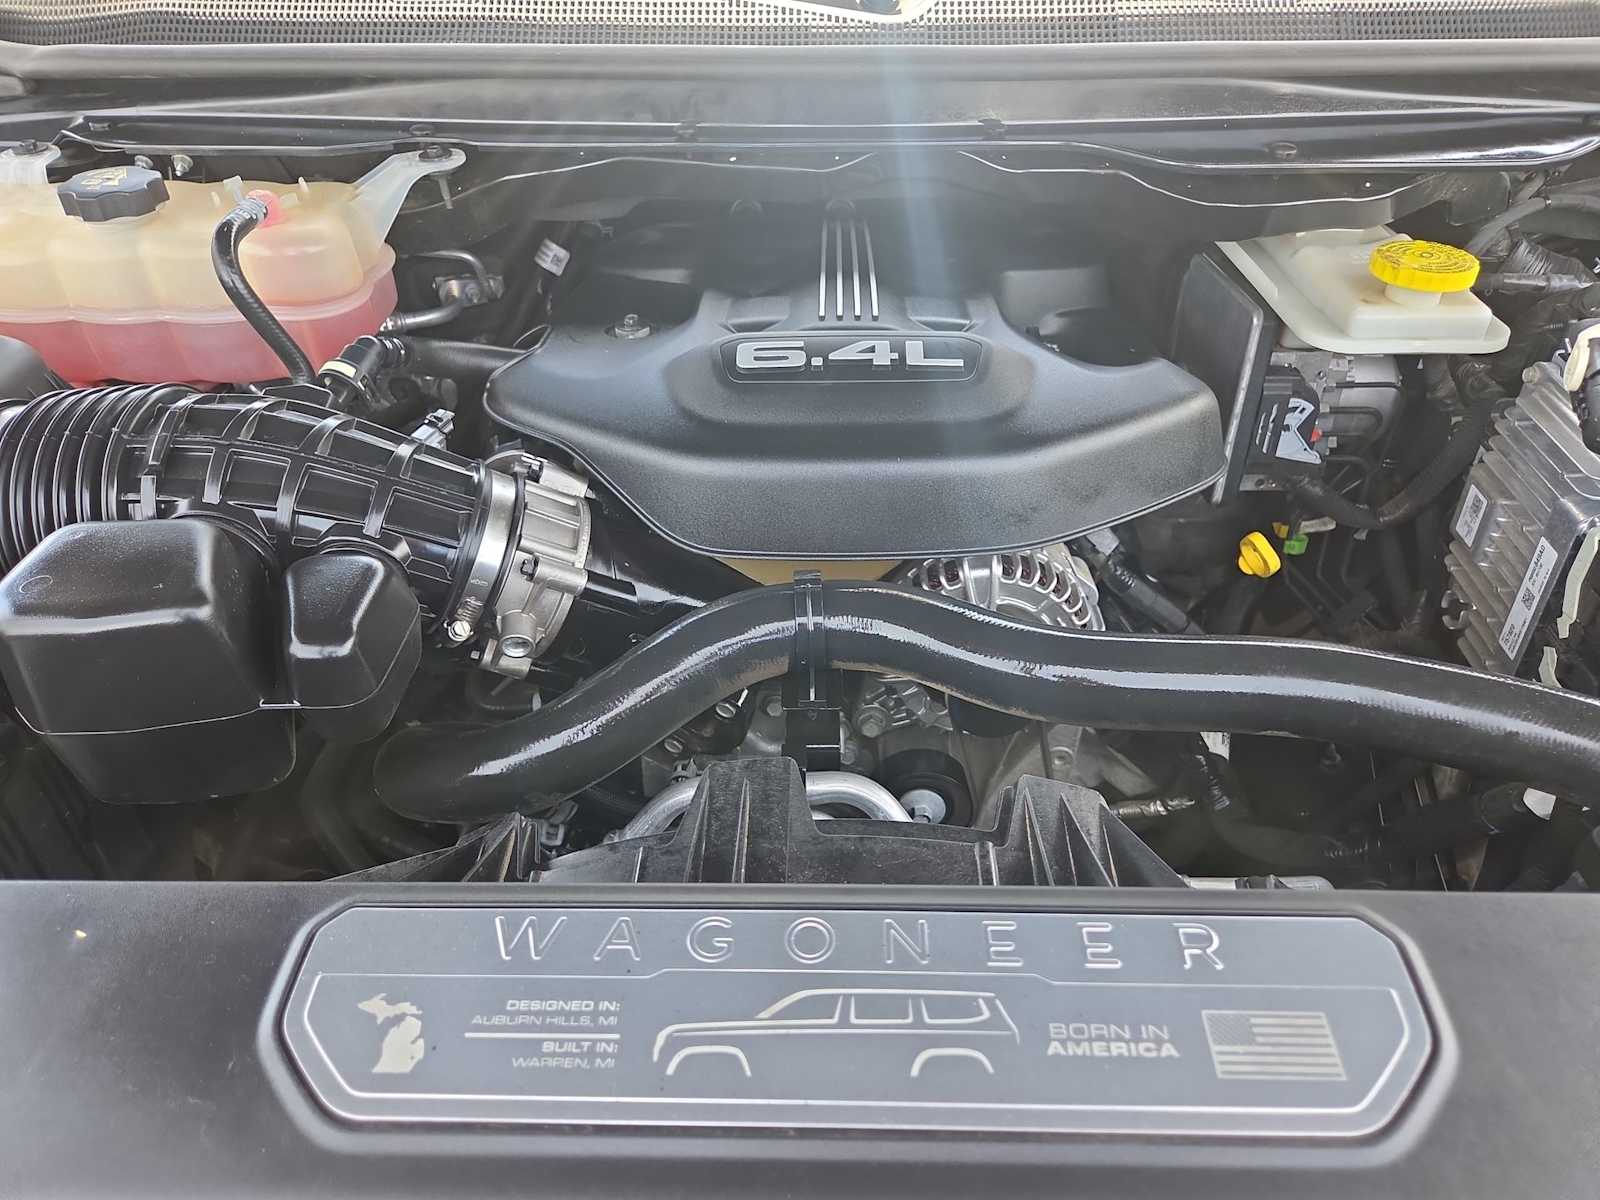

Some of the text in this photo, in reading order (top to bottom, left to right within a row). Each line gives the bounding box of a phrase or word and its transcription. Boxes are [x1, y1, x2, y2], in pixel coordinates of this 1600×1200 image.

[736, 340, 964, 369] 6.4L
[495, 915, 1225, 970] WAGONEER
[506, 999, 621, 1012] DESIGNED IN:
[471, 1014, 543, 1026] AUBURN
[598, 1015, 618, 1026] MI
[1048, 1022, 1170, 1040] BORN IN
[541, 1041, 619, 1054] BUILT IN:
[1046, 1040, 1181, 1058] AMERICA
[594, 1057, 616, 1069] MI
